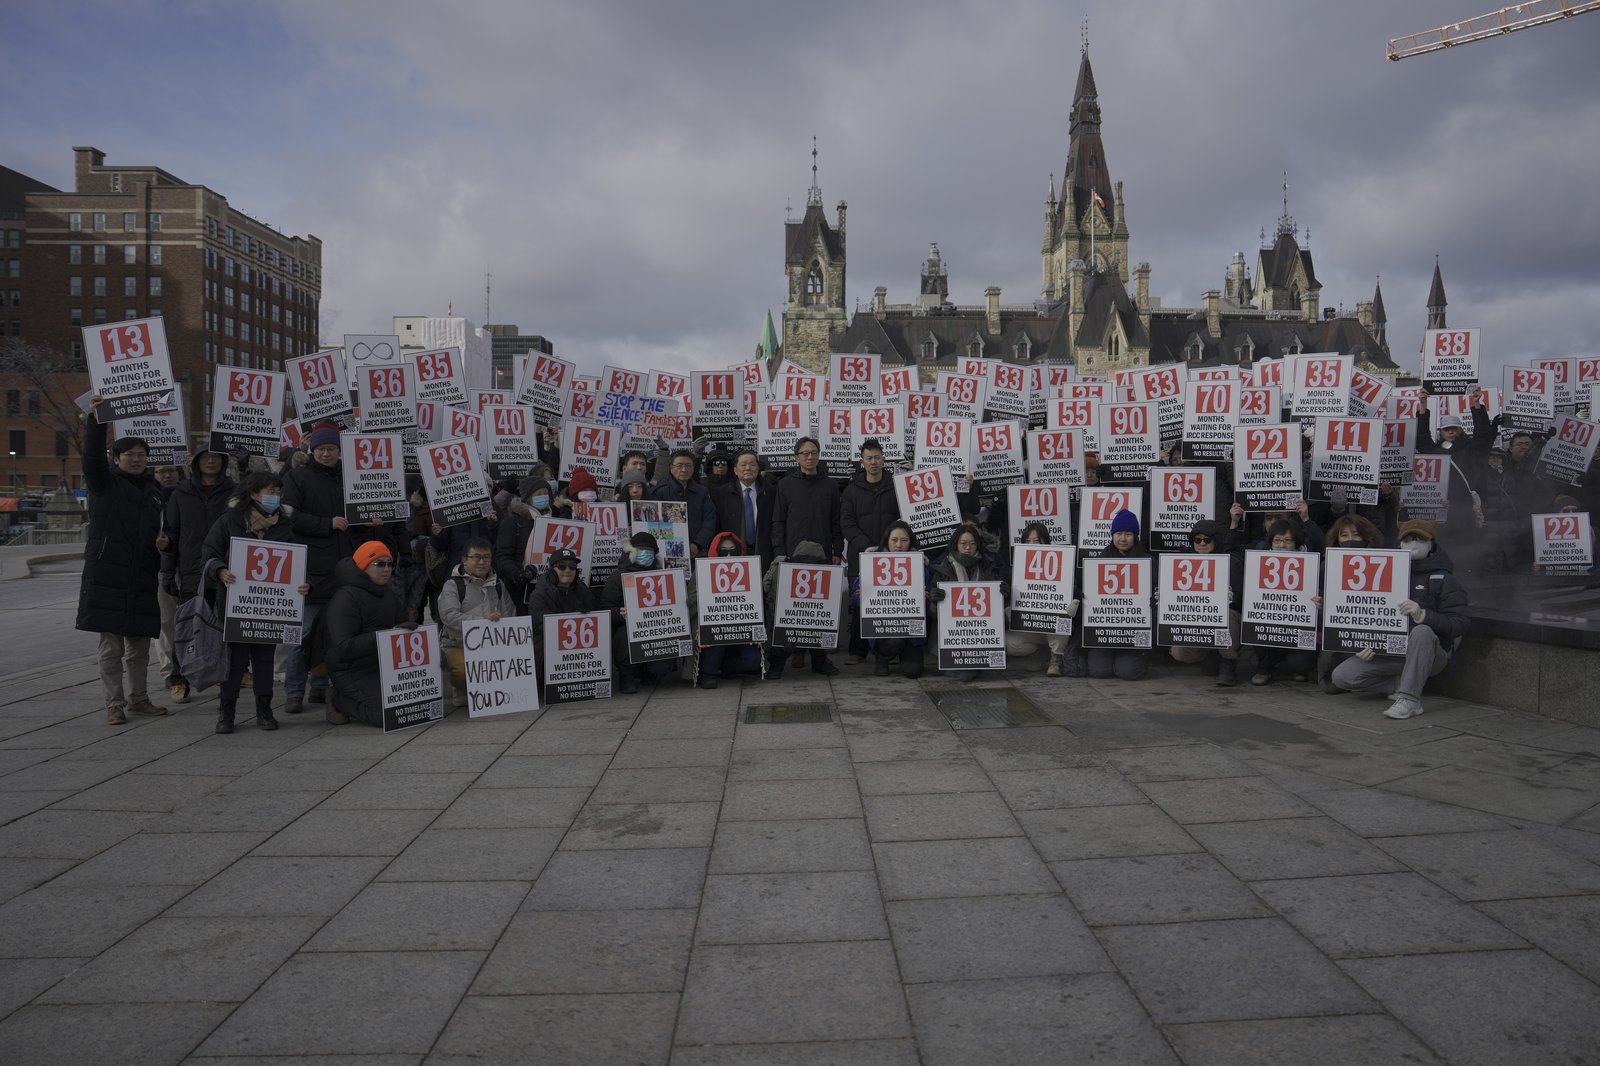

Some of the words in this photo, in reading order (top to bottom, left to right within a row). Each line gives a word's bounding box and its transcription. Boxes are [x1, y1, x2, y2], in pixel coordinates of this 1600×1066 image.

[105, 325, 146, 358] 13
[1438, 332, 1466, 355] 38
[102, 372, 141, 385] WAITING
[142, 369, 161, 379] FOR
[110, 361, 149, 374] MONTHS
[302, 357, 334, 389] 30
[418, 352, 450, 380] 35
[535, 357, 564, 386] 42
[843, 357, 868, 381] 53
[997, 365, 1021, 391] 33
[1308, 360, 1337, 386] 35
[119, 378, 168, 393] RESPONSE
[232, 372, 269, 403] 30
[371, 368, 403, 397] 36
[612, 371, 636, 395] 39
[659, 375, 682, 396] 37
[706, 375, 729, 397] 11
[789, 377, 812, 400] 15
[948, 377, 974, 404] 68
[1148, 369, 1178, 398] 33
[1352, 375, 1379, 403] 27
[1516, 370, 1542, 393] 32
[603, 392, 634, 408] STOP
[639, 397, 665, 412] THE
[911, 395, 936, 418] 34
[1199, 385, 1227, 413] 70
[1240, 391, 1267, 415] 23
[1509, 399, 1534, 407] WAITING
[1516, 393, 1541, 401] MONTHS
[222, 413, 255, 424] WAITING
[257, 417, 272, 426] FOR
[231, 405, 264, 416] MONTHS
[495, 410, 523, 434] 40
[771, 405, 796, 428] 71
[864, 409, 890, 433] 63
[1062, 400, 1088, 426] 55
[1113, 407, 1143, 434] 90
[235, 423, 276, 435] RESPONSE
[455, 413, 478, 437] 20
[929, 421, 957, 447] 68
[1332, 421, 1363, 451] 11
[1563, 420, 1590, 445] 30
[576, 428, 608, 456] 54
[981, 427, 1008, 451] 55
[1041, 432, 1070, 459] 34
[1250, 428, 1283, 459] 22
[356, 439, 388, 468] 34
[432, 444, 468, 476] 38
[1120, 452, 1156, 460] RESPONSE
[360, 472, 389, 481] MONTHS
[440, 474, 469, 486] MONTHS
[1415, 458, 1437, 482] 31
[353, 481, 382, 490] WAITING
[383, 481, 397, 489] FOR
[365, 489, 401, 499] RESPONSE
[435, 483, 464, 496] WAITING
[464, 480, 479, 490] FOR
[448, 487, 484, 502] RESPONSE
[907, 472, 940, 501] 39
[1167, 473, 1198, 502] 65
[369, 510, 393, 518] RESULTS
[1023, 488, 1054, 516] 40
[1096, 492, 1125, 520] 72
[446, 514, 456, 522] NO
[455, 508, 480, 520] RESULTS
[591, 507, 615, 535] 40
[548, 525, 580, 553] 42
[1547, 516, 1577, 539] 22
[250, 546, 287, 582] 37
[876, 557, 908, 585] 35
[1027, 550, 1059, 581] 40
[1177, 559, 1211, 591] 34
[1263, 556, 1300, 591] 36
[1347, 554, 1387, 592] 37
[714, 562, 746, 592] 62
[794, 568, 826, 598] 81
[1103, 563, 1134, 594] 51
[238, 594, 275, 606] WAITING
[277, 597, 294, 607] FOR
[248, 585, 285, 596] MONTHS
[640, 574, 672, 605] 31
[714, 595, 745, 603] MONTHS
[955, 587, 986, 616] 43
[1176, 595, 1210, 604] MONTHS
[1262, 592, 1297, 603] MONTHS
[253, 606, 298, 618] RESPONSE
[707, 604, 738, 613] WAITING
[739, 603, 754, 611] FOR
[720, 612, 759, 621] RESPONSE
[1168, 603, 1200, 613] WAITING
[1203, 605, 1218, 613] FOR
[1181, 613, 1223, 623] RESPONSE
[1252, 601, 1287, 612] WAITING
[1289, 604, 1306, 613] FOR
[1266, 612, 1311, 623] RESPONSE
[465, 625, 533, 651] CANADA
[561, 618, 594, 649] 36
[1183, 635, 1211, 643] RESULTS
[395, 632, 426, 666] 18
[466, 659, 506, 684] WHAT
[506, 658, 533, 680] ARE
